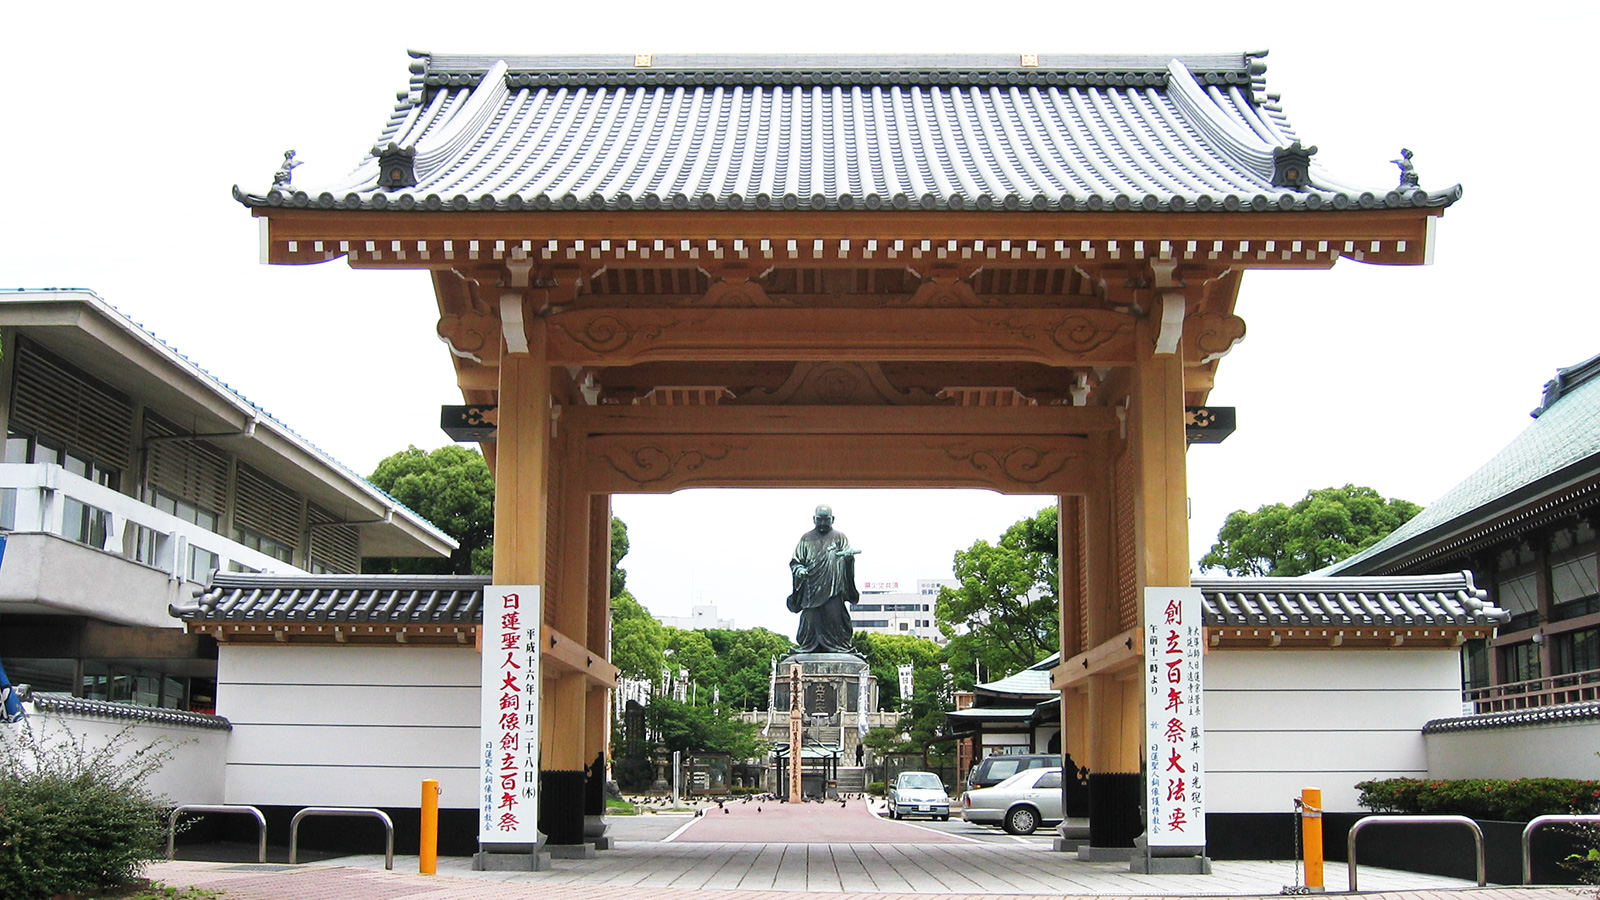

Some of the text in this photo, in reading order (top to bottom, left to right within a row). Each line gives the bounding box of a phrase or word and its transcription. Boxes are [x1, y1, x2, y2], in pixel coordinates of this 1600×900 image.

[497, 593, 521, 832] 日蓮聖人大銅像創立百年祭
[1149, 624, 1159, 696] 午前十一時より
[1164, 600, 1187, 833] 創立百年祭大法要
